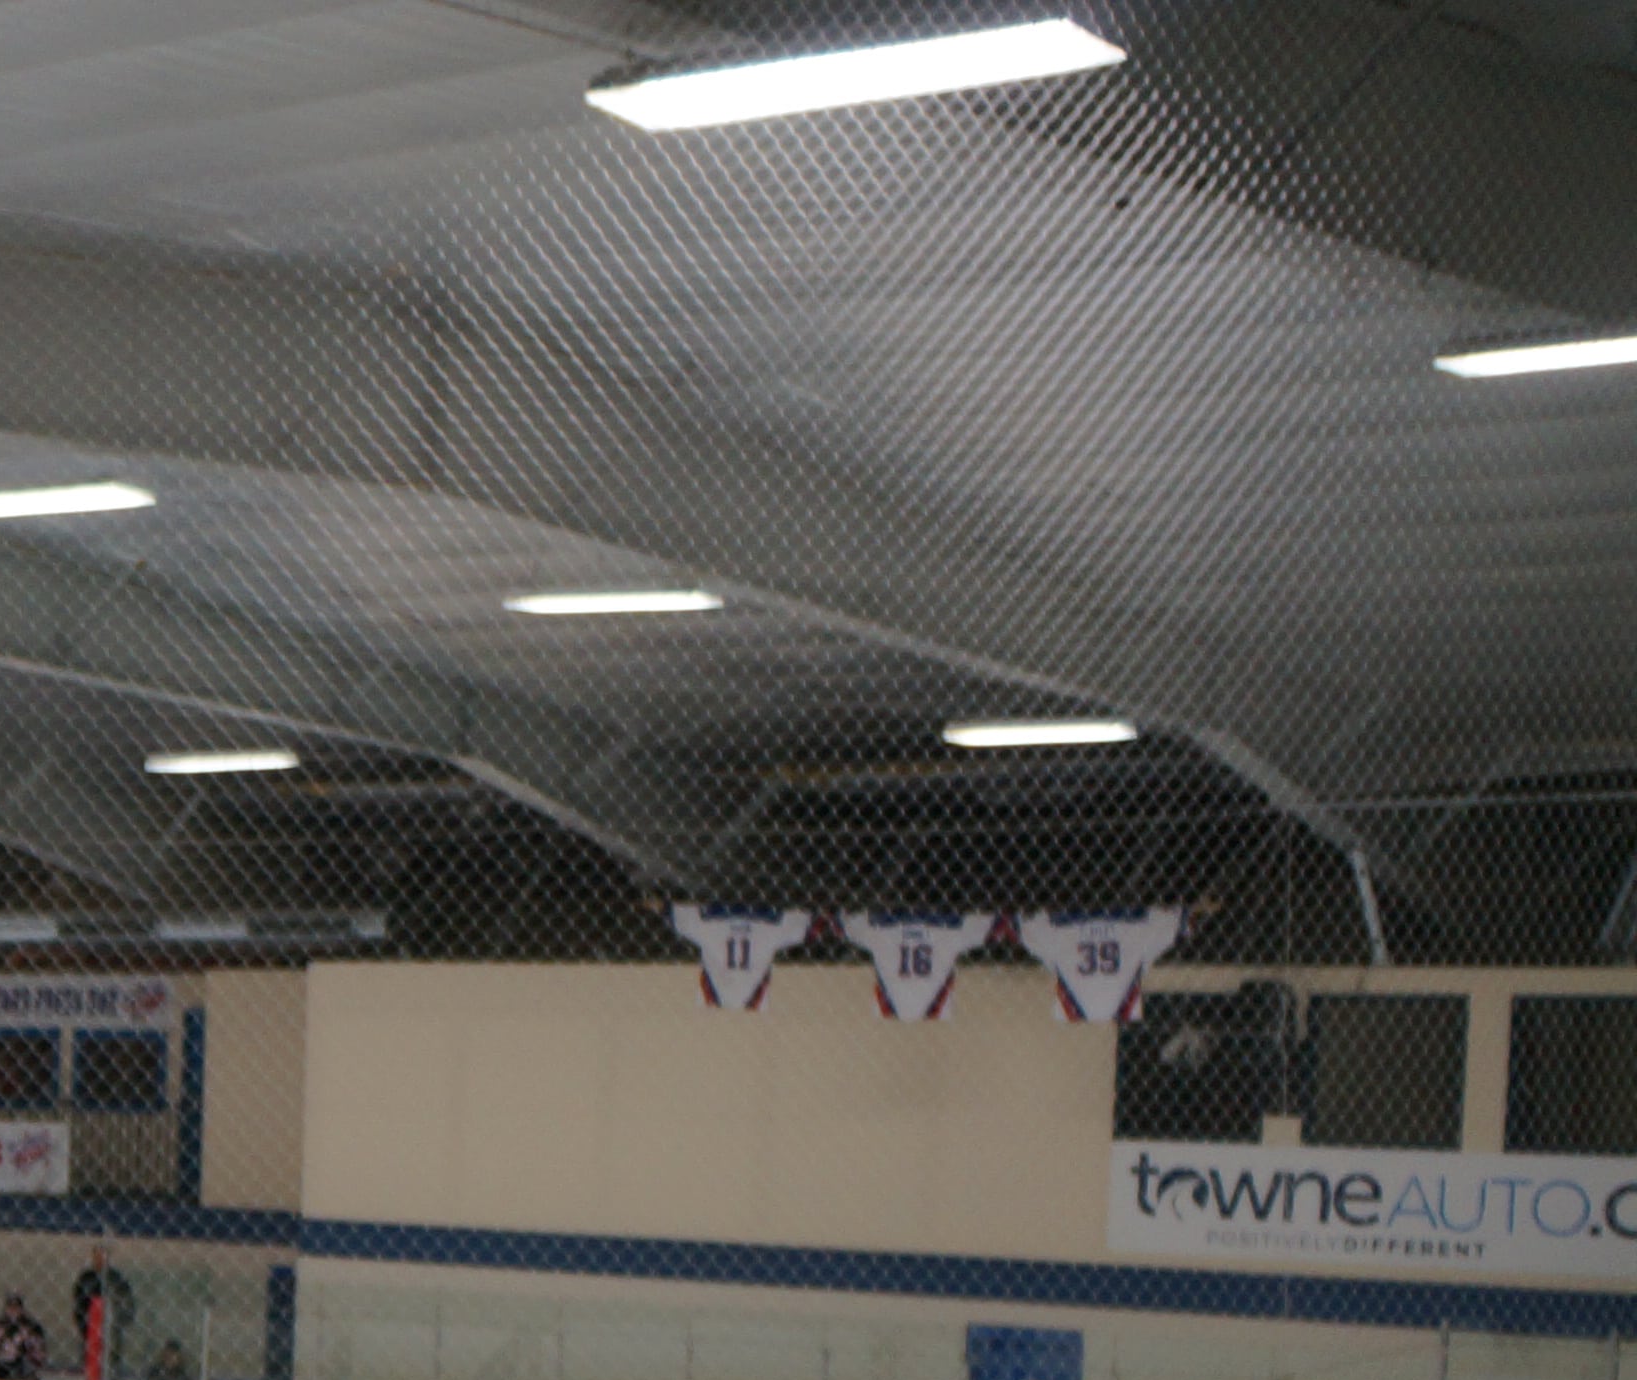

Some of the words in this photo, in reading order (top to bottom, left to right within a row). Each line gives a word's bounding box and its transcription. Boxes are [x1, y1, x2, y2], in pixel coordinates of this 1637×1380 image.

[725, 937, 751, 972] 11
[897, 943, 933, 979] 16
[1076, 939, 1122, 976] 39
